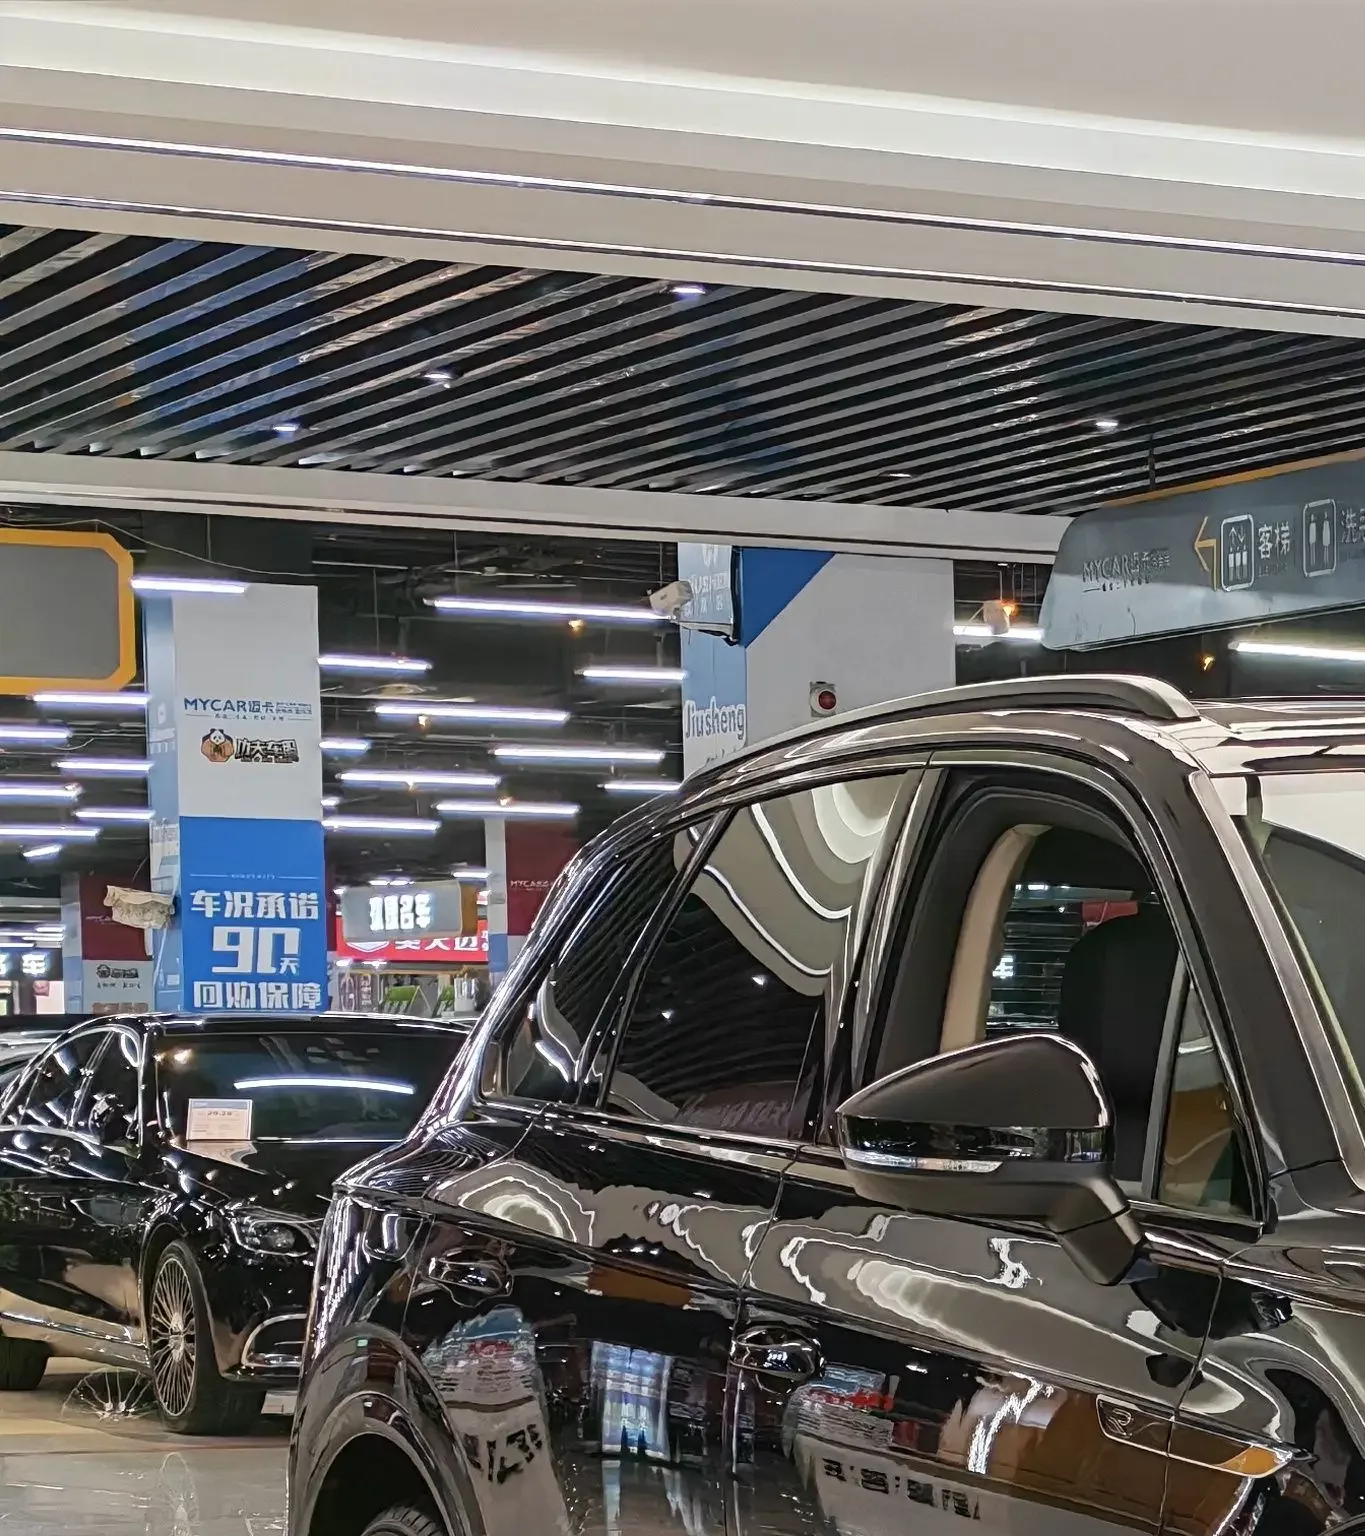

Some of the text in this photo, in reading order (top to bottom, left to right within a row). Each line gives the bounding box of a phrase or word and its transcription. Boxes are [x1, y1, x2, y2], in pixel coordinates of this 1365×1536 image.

[1257, 520, 1291, 559] 客梯
[190, 890, 319, 919] 车况承诺
[193, 981, 322, 1010] 回购保障
